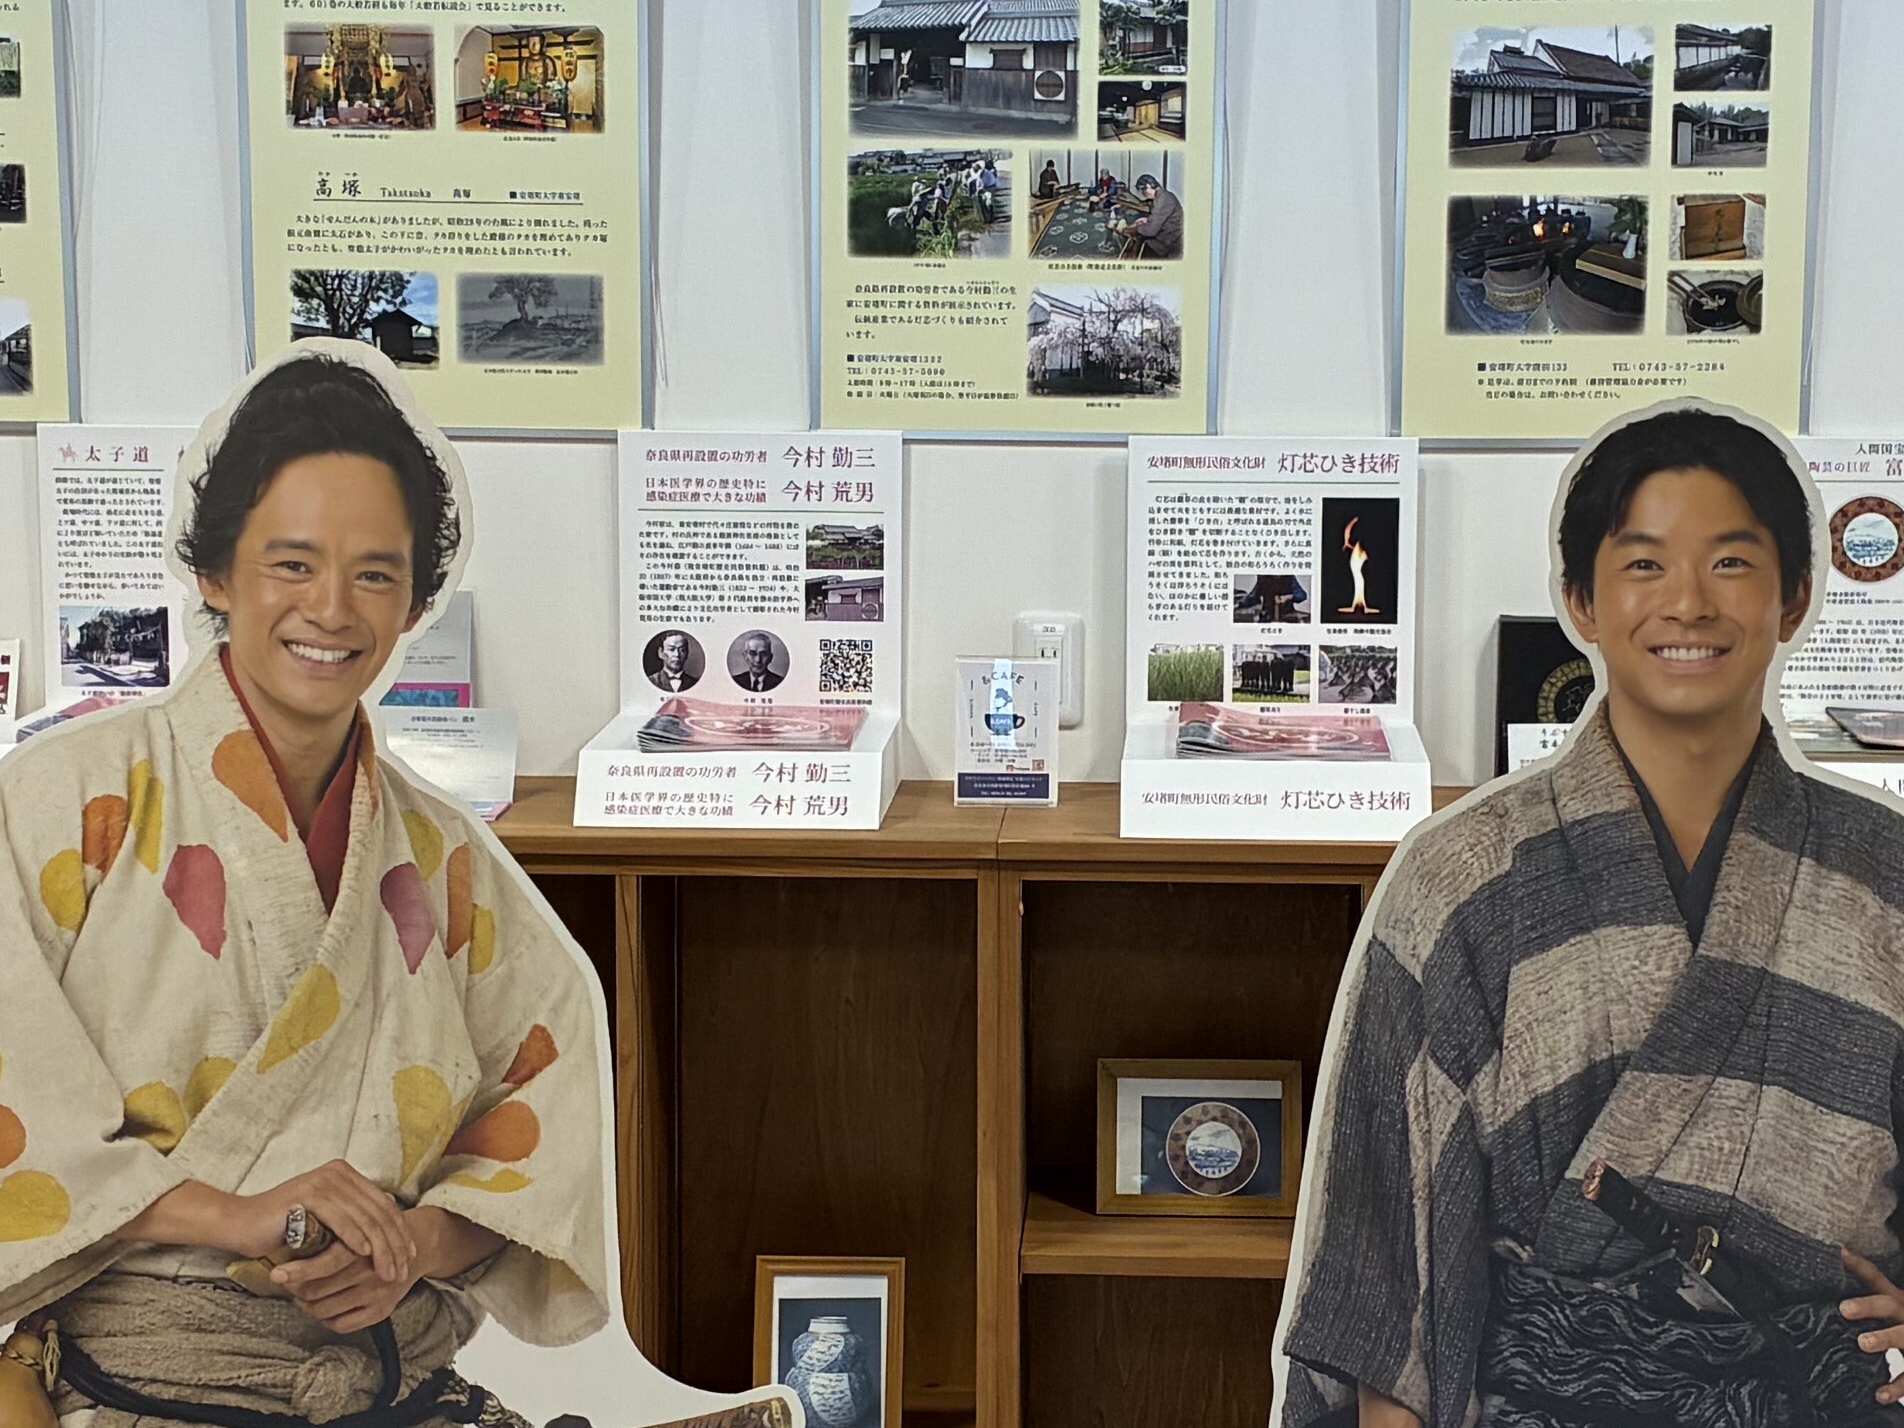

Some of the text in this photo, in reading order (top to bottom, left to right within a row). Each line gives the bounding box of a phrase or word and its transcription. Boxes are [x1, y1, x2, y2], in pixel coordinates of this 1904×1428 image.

[316, 178, 361, 197] 高塚
[381, 188, 431, 198] Takatsuka
[85, 445, 149, 463] 太子道
[646, 446, 875, 468] 奈良県再設置の功労者 今村 勤三
[1856, 443, 1904, 455] 人間国宝
[1148, 453, 1399, 473] 安堵町無形民俗文化財 灯芯ひき技術
[1809, 462, 1870, 472] 陶芸の巨匠
[647, 477, 766, 489] 日本医学界の歴史特に
[783, 480, 874, 502] 今村 荒男
[646, 491, 766, 503] 感染症医療で大きな功績
[982, 672, 1024, 684] &CAFE
[607, 762, 851, 784] 奈良県再設置の功労者 今村 勤三
[604, 791, 733, 803] 日本医学界の歴史特に
[749, 795, 849, 817] 今村 荒男
[1143, 790, 1410, 811] 安堵町無形民俗文化財 灯芯ひき技術
[604, 804, 733, 818] 感染症医療で大きな功績
